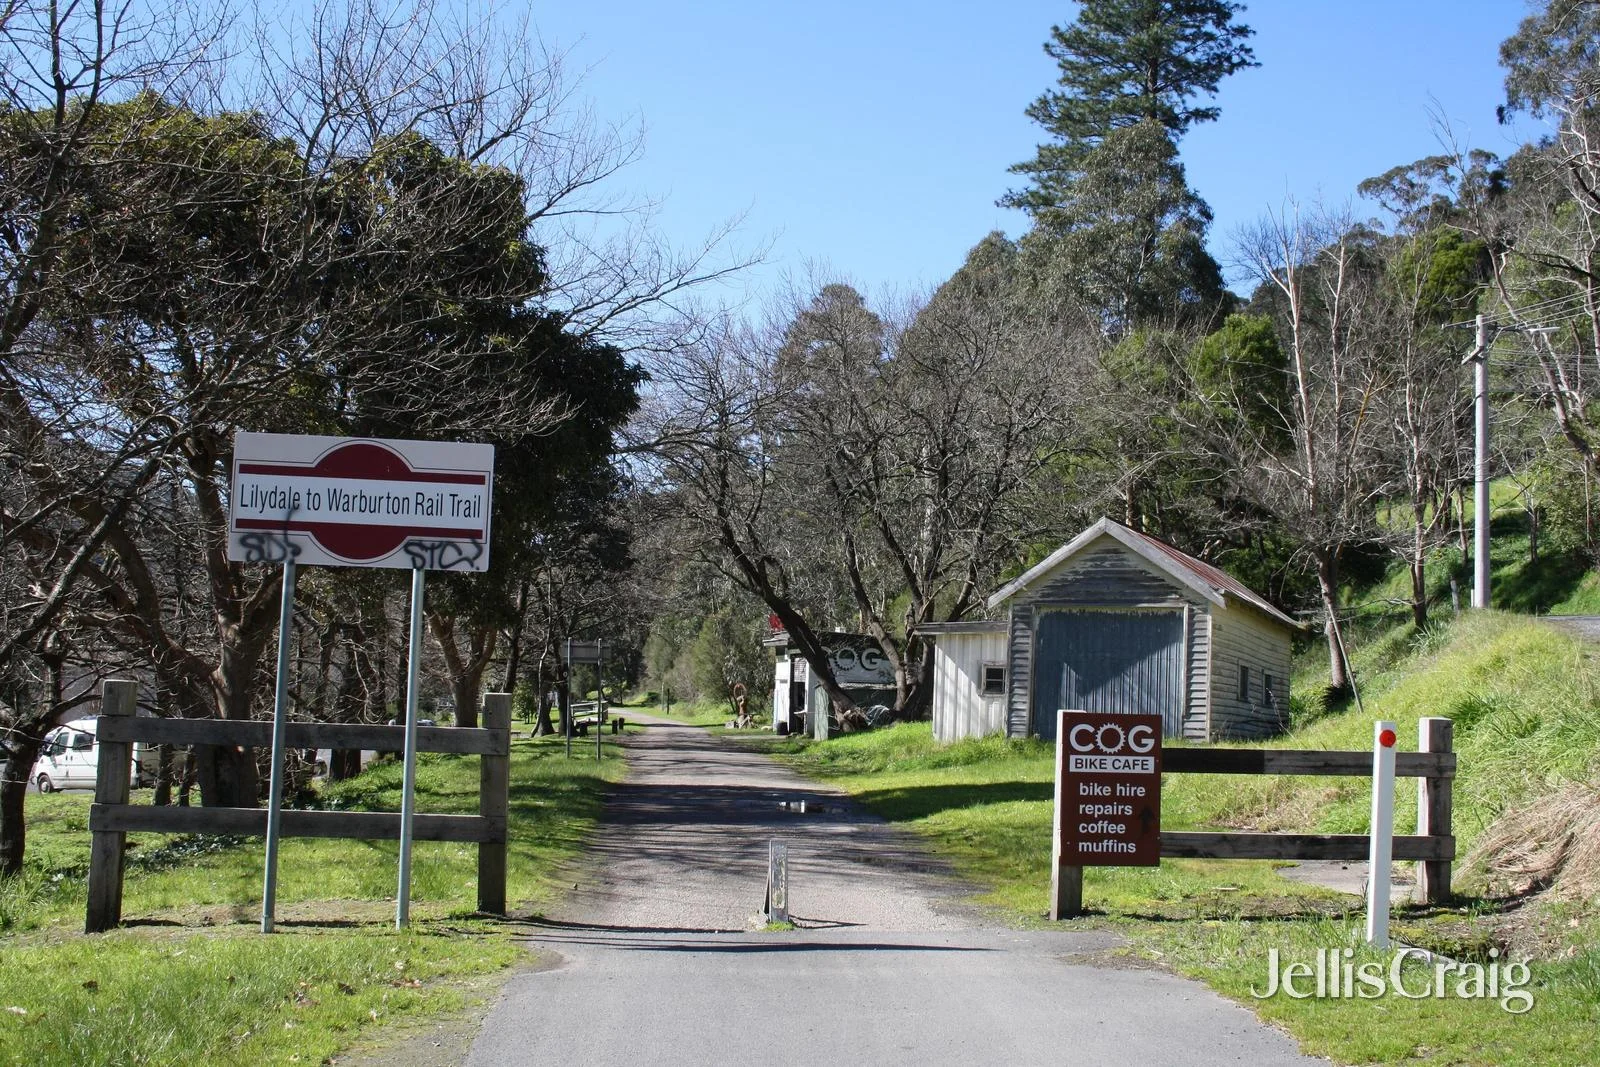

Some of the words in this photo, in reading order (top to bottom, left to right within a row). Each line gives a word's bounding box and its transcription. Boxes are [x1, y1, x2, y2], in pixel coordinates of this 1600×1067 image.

[240, 483, 300, 514] Lilydale
[306, 488, 321, 511] to
[327, 487, 410, 515] Warburton
[415, 491, 444, 517] Rail
[449, 493, 481, 518] Trail
[1069, 722, 1155, 755] COG
[1074, 758, 1107, 770] BIKE
[1112, 759, 1149, 771] CAFE
[1079, 782, 1111, 796] bike
[1116, 783, 1146, 797] hire
[1079, 802, 1133, 818] repairs
[1078, 820, 1126, 834] coffee
[1078, 839, 1137, 853] muffins
